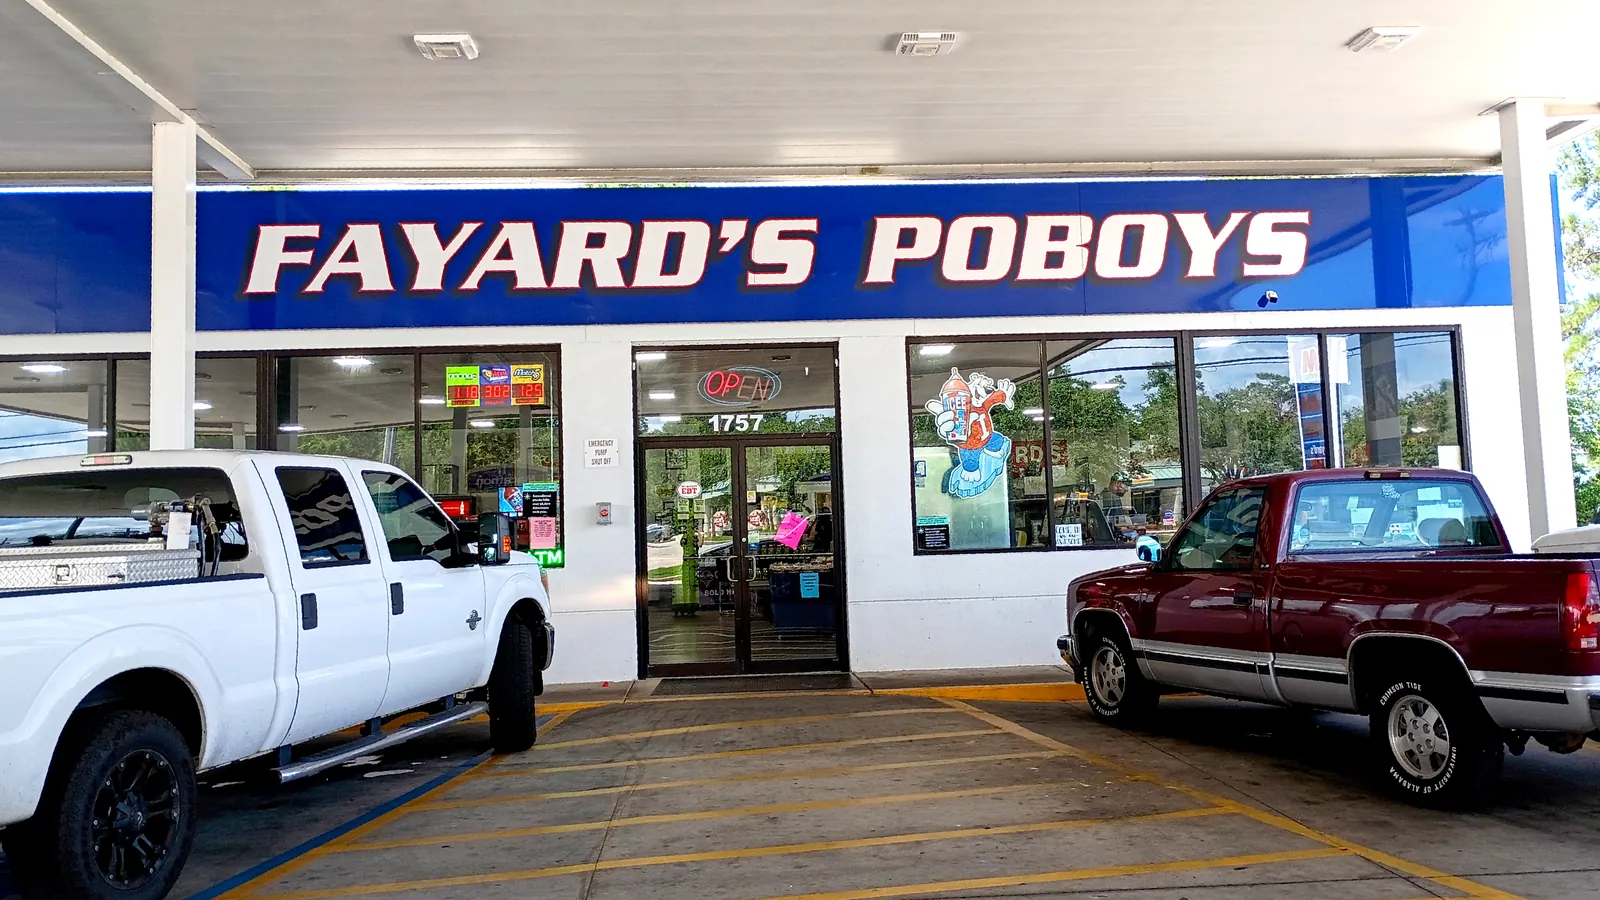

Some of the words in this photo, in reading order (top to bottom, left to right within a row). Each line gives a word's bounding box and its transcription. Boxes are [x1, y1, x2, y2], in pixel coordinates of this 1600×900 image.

[243, 218, 819, 294] FAYARD'S
[862, 210, 1311, 284] POBOYS
[457, 386, 477, 398] 118
[485, 385, 509, 398] 302
[521, 384, 541, 397] 125
[706, 370, 770, 401] OPEN
[708, 414, 763, 432] 1757
[529, 550, 562, 564] TM
[1380, 682, 1404, 706] CRIMSON
[1406, 681, 1421, 691] TIDE
[1434, 746, 1457, 791] UNIVERSITY
[1389, 766, 1420, 793] ALABAMA
[1423, 786, 1431, 794] OF
